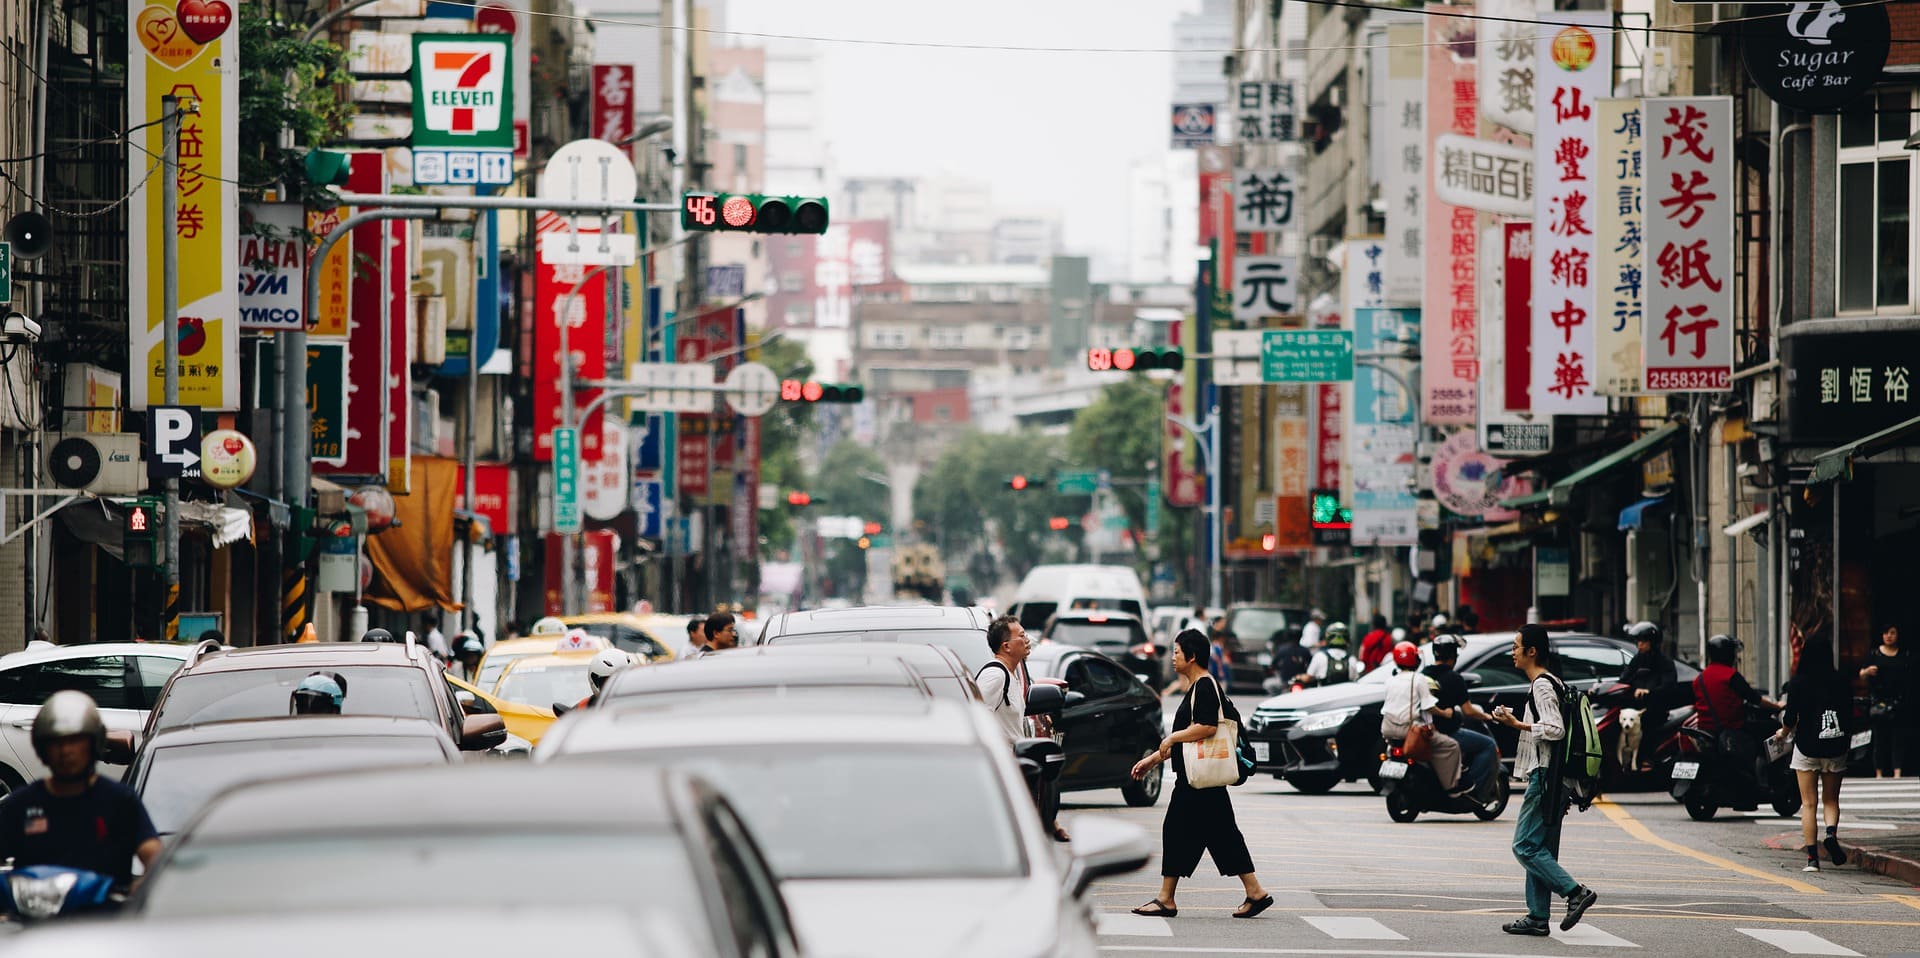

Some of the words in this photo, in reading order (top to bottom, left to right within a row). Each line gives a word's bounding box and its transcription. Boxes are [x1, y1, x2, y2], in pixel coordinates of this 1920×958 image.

[1778, 50, 1854, 73] Sugar
[1824, 75, 1851, 87] Bar
[686, 196, 716, 225] 46
[1547, 86, 1594, 399] 仙豐濃縮中藥
[1656, 105, 1722, 360] 茂芳紙行
[239, 238, 299, 269] AHA
[1650, 371, 1728, 389] 25583216
[155, 408, 193, 455] P
[313, 443, 338, 456] 118
